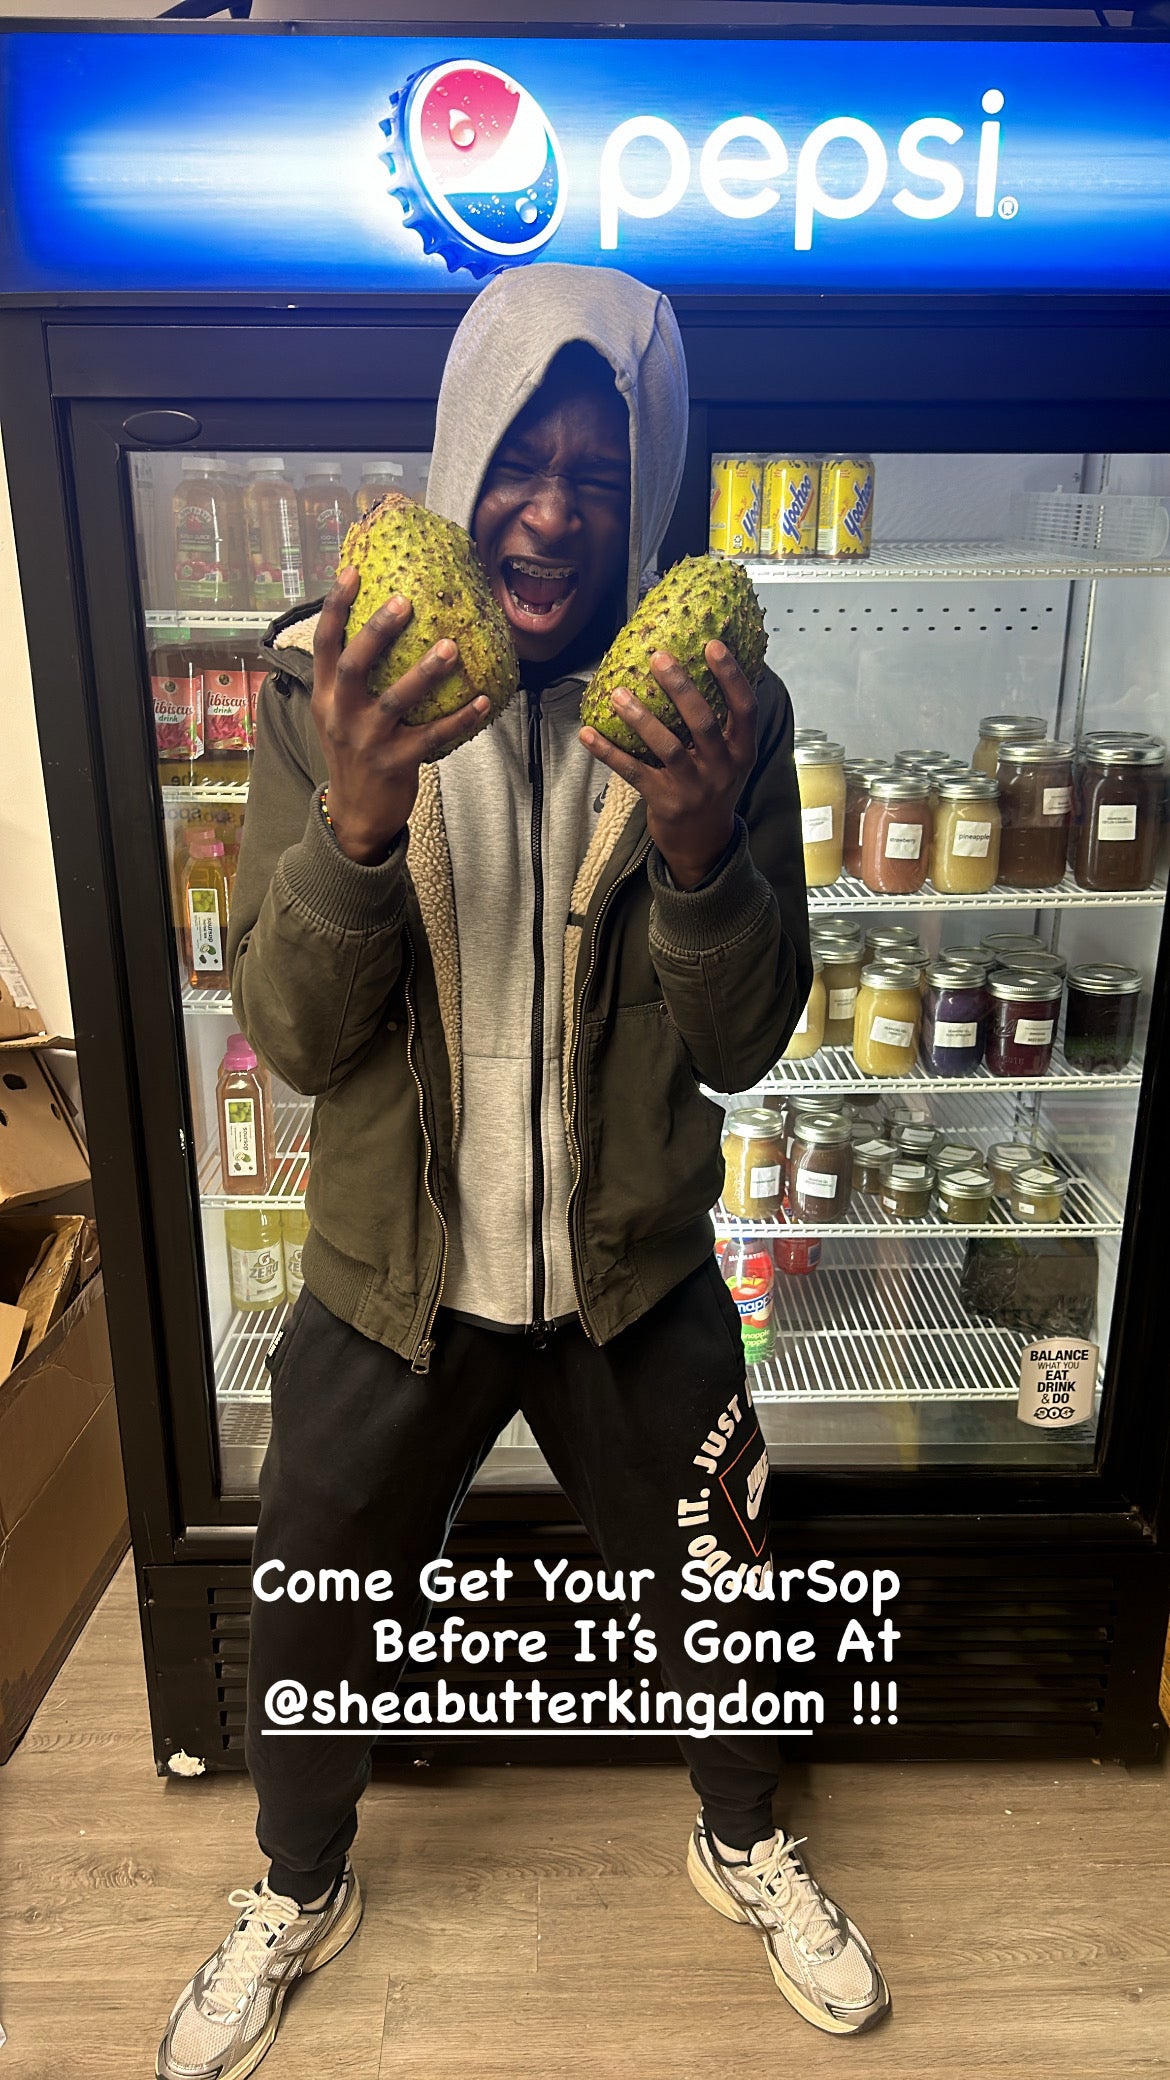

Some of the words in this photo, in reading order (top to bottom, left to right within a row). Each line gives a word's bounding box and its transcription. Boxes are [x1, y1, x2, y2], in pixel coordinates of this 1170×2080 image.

[153, 698, 193, 715] ibiscus
[889, 836, 917, 846] strawberry
[958, 832, 991, 842] pineapple
[249, 1260, 279, 1279] ZERO
[737, 1295, 771, 1312] napp
[1030, 1349, 1089, 1361] BALANCE
[1037, 1361, 1062, 1370] WHAT
[1063, 1361, 1080, 1369] YOU
[1037, 1381, 1076, 1393] DRINK
[1041, 1393, 1050, 1404] &
[1052, 1393, 1070, 1404] DO
[693, 1394, 743, 1475] JUST
[677, 1487, 711, 1527] IT.
